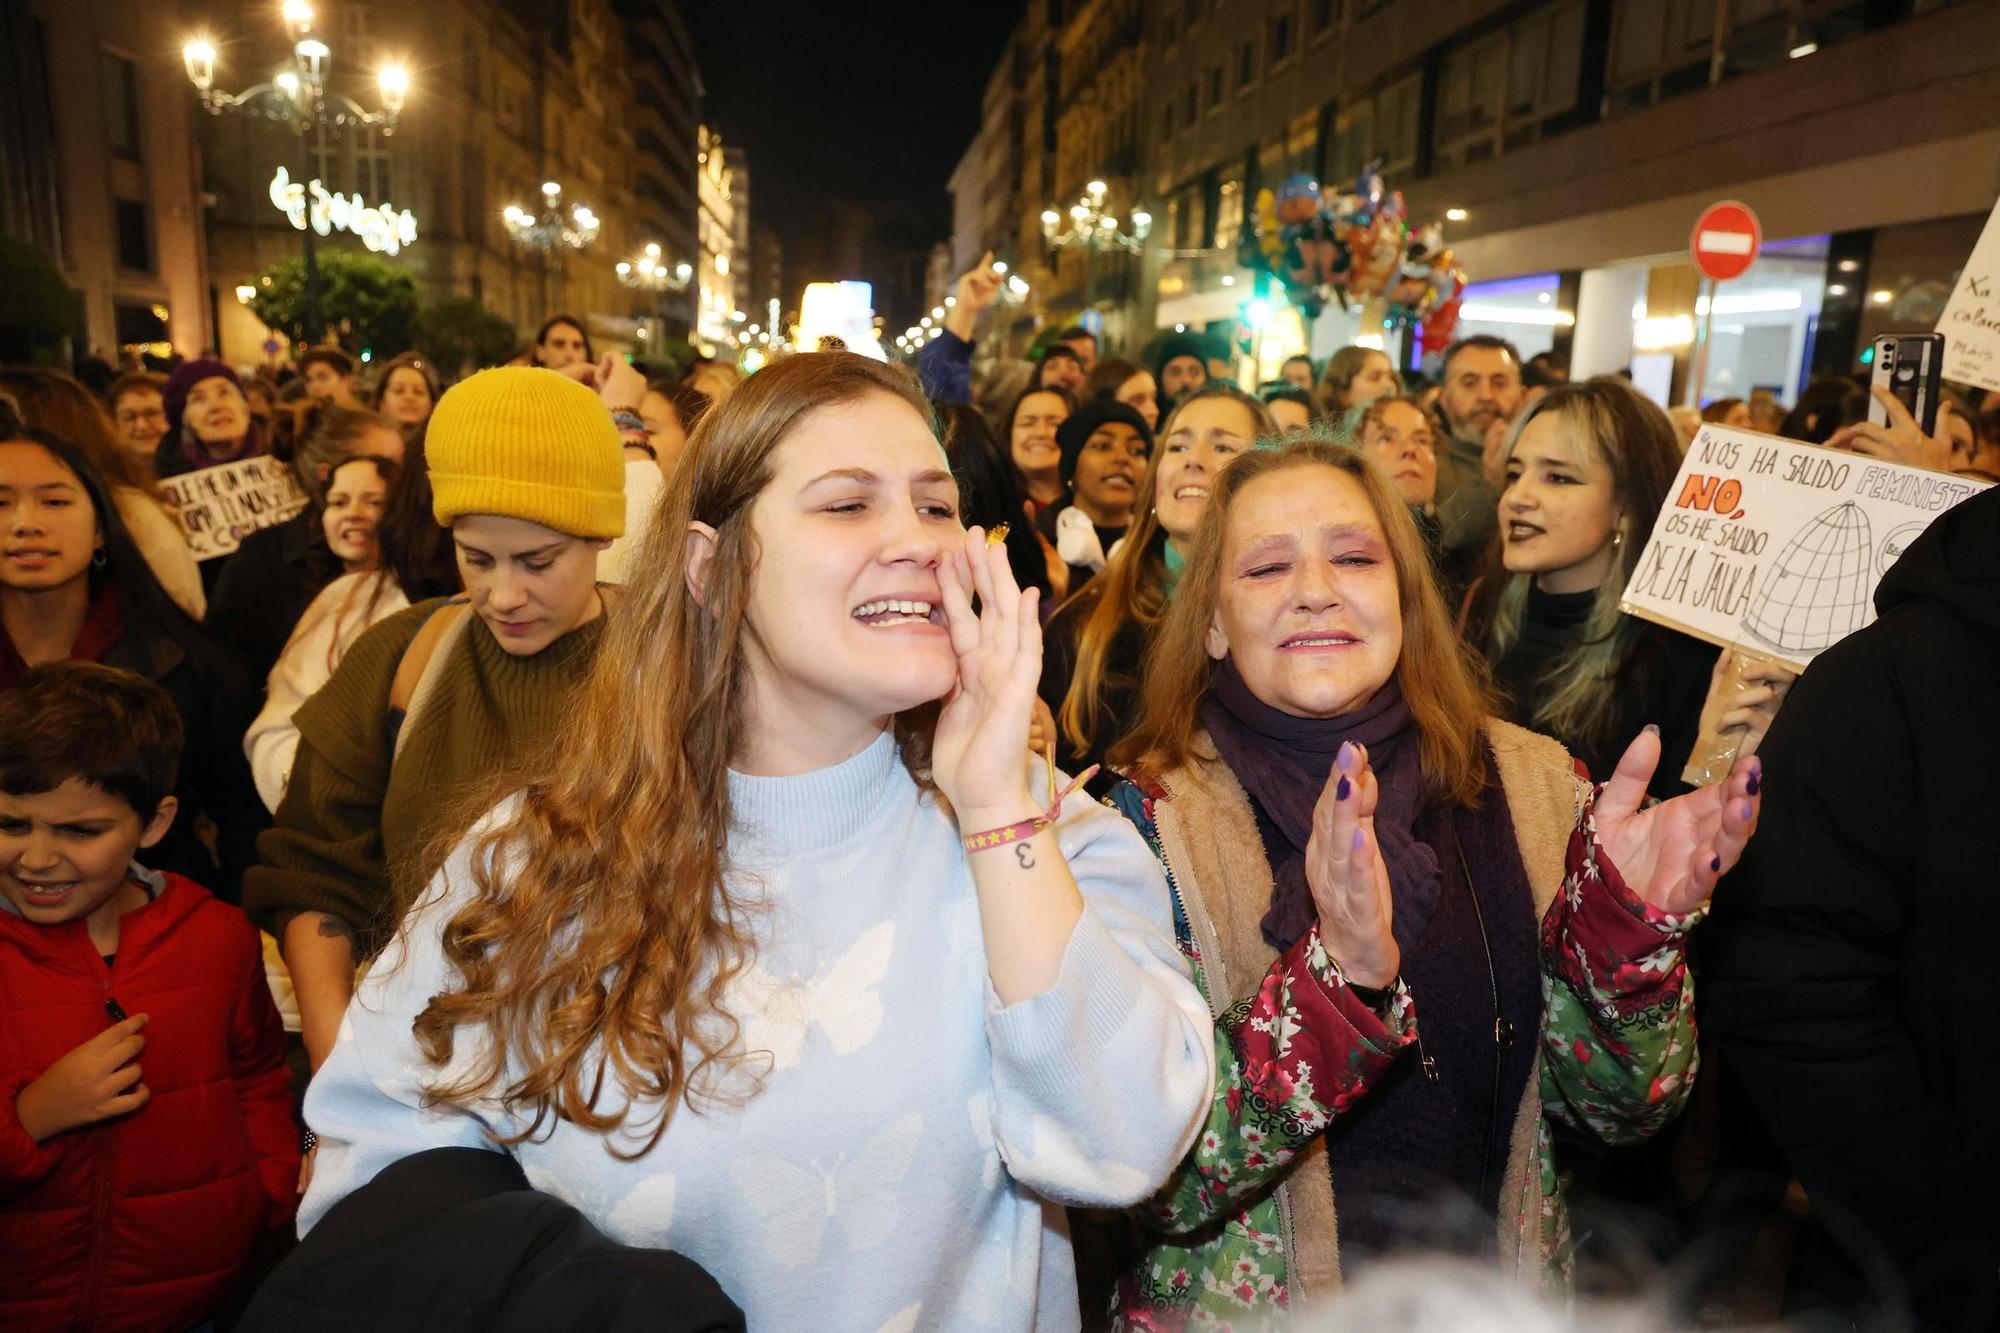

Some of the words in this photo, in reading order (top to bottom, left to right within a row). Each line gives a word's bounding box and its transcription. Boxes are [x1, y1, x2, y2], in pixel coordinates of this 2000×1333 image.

[1675, 474, 1745, 520] NO,
[1749, 446, 1778, 475] HA
[1783, 454, 1849, 492] SALIDO
[1855, 464, 1983, 512] FEMINIST
[1665, 513, 1690, 534] OS
[1690, 517, 1717, 542] HE
[1714, 523, 1769, 556] SALIDO
[1634, 541, 1673, 597] DE
[1661, 546, 1696, 603] LA
[1693, 551, 1758, 618] JAULA
